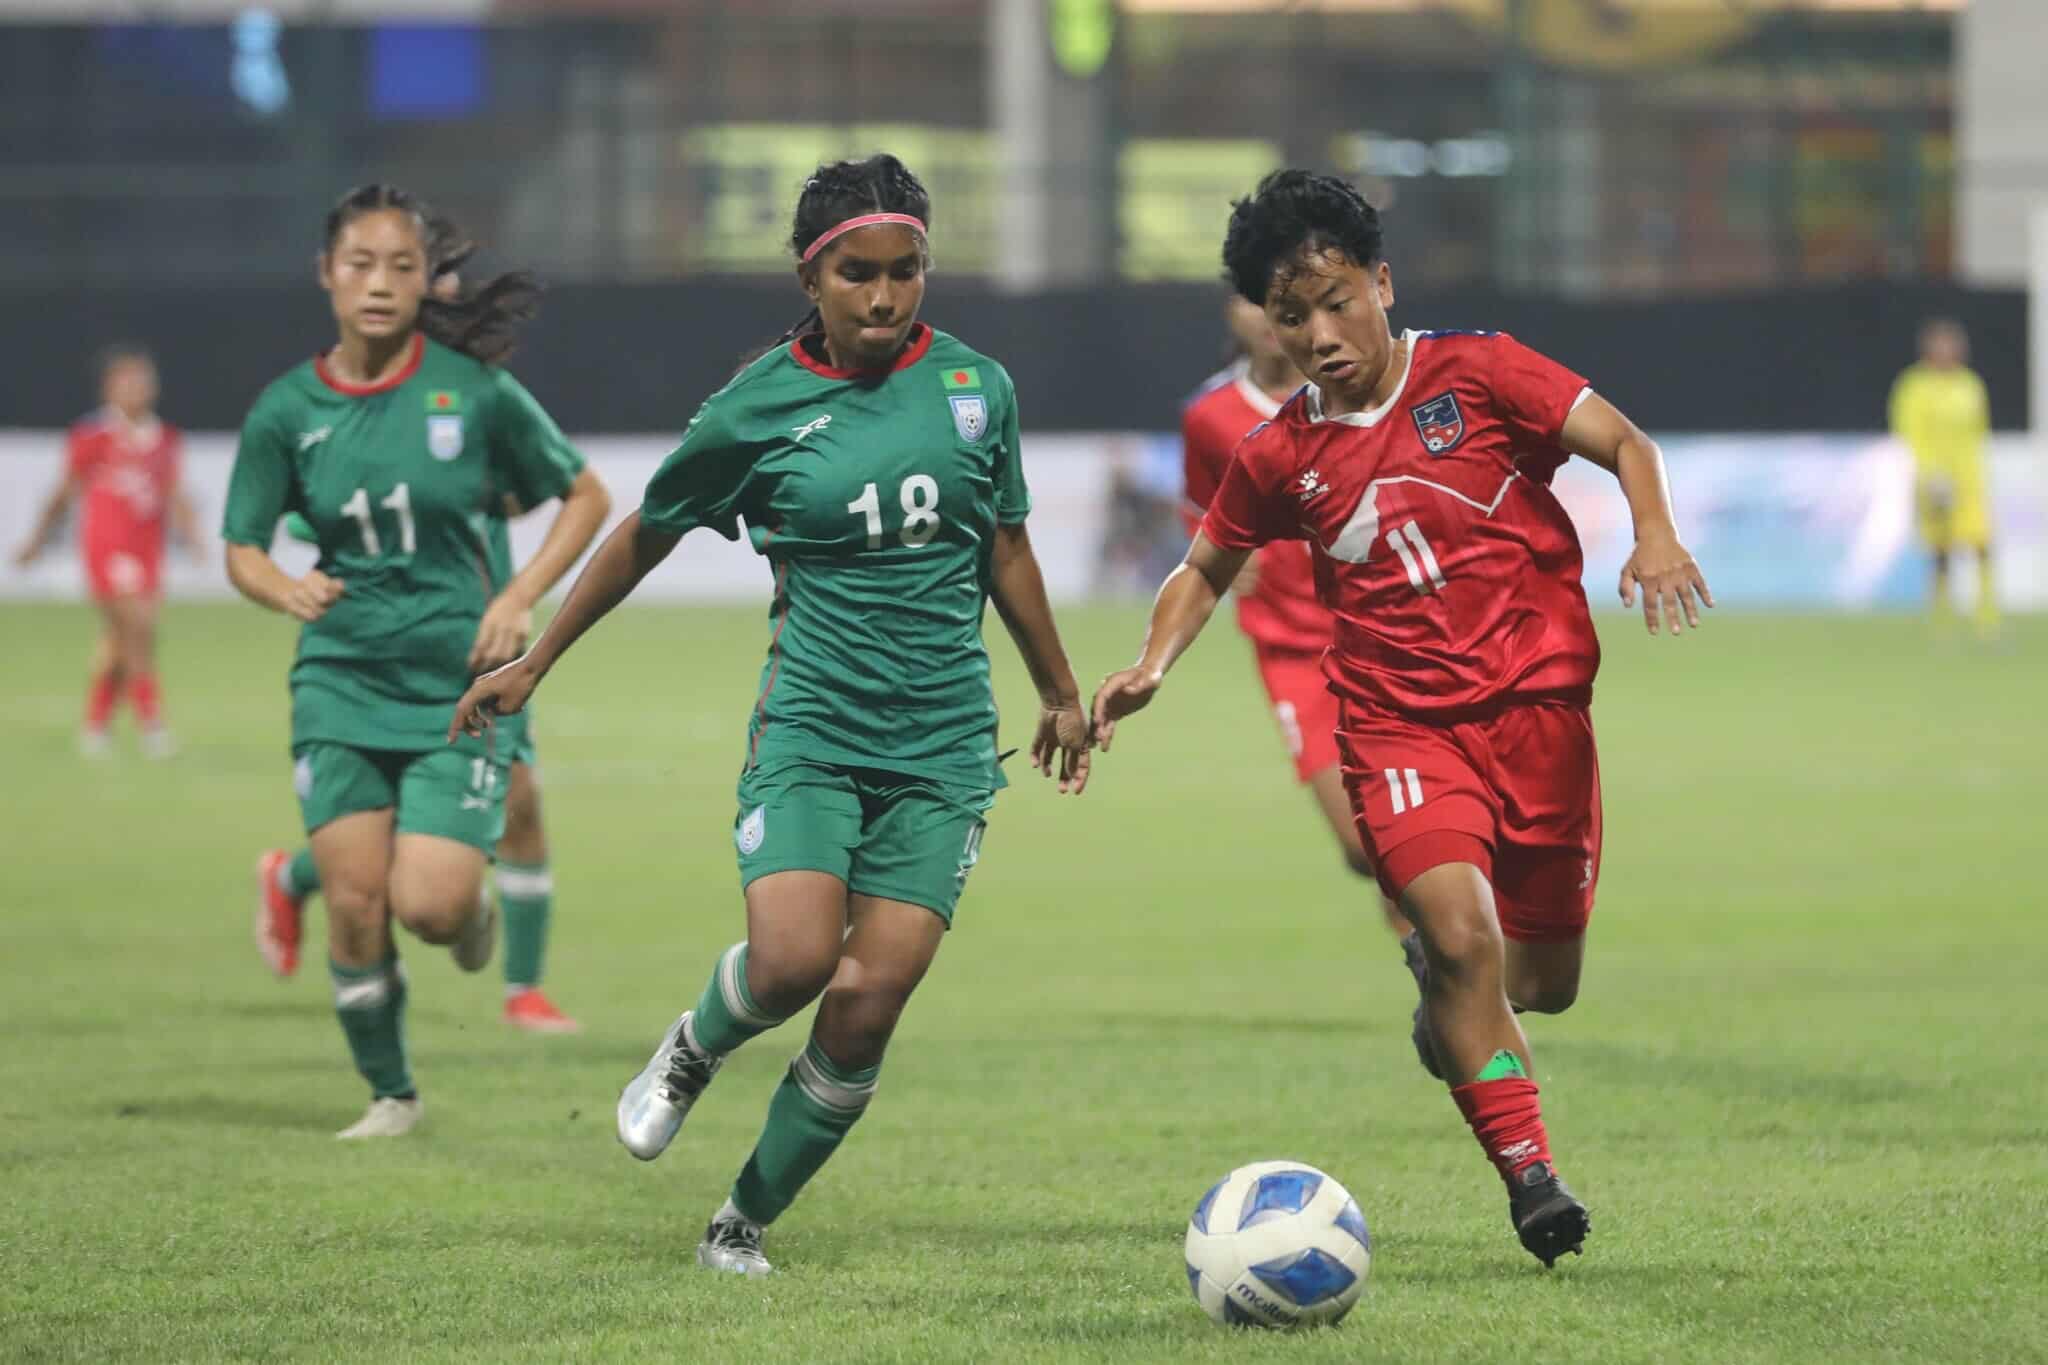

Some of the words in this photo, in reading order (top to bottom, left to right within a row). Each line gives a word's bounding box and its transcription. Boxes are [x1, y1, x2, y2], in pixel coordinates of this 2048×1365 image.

[341, 483, 416, 557] 11
[847, 474, 941, 549] 18
[1386, 520, 1447, 595] 11
[1384, 768, 1424, 815] 11
